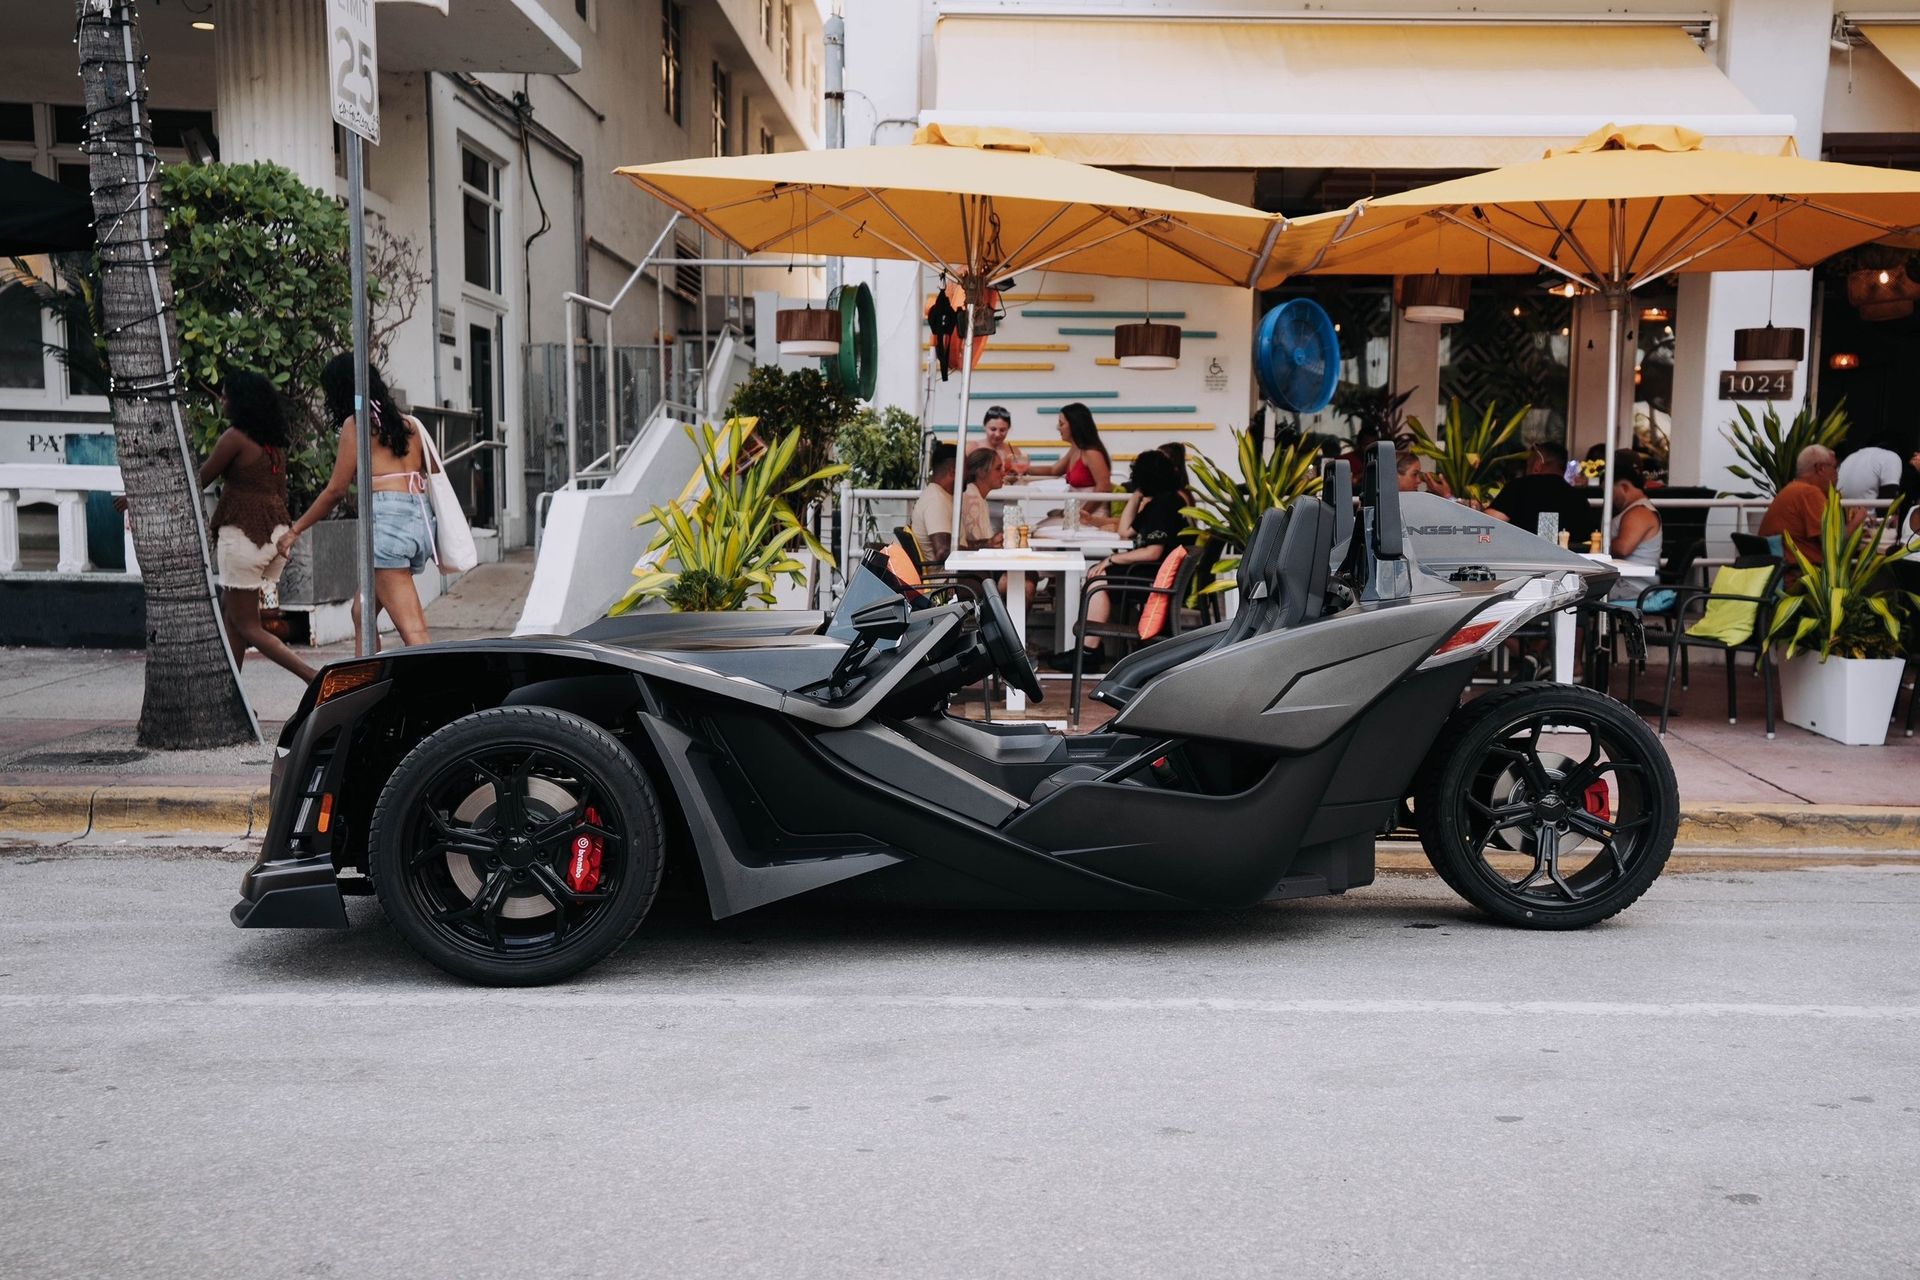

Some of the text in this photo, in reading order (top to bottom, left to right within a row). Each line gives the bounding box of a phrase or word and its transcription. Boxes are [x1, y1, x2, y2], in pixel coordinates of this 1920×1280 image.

[335, 26, 375, 116] 25
[1728, 374, 1786, 393] 1024
[27, 434, 64, 453] PA
[1478, 535, 1491, 544] R
[575, 849, 586, 878] brembo
